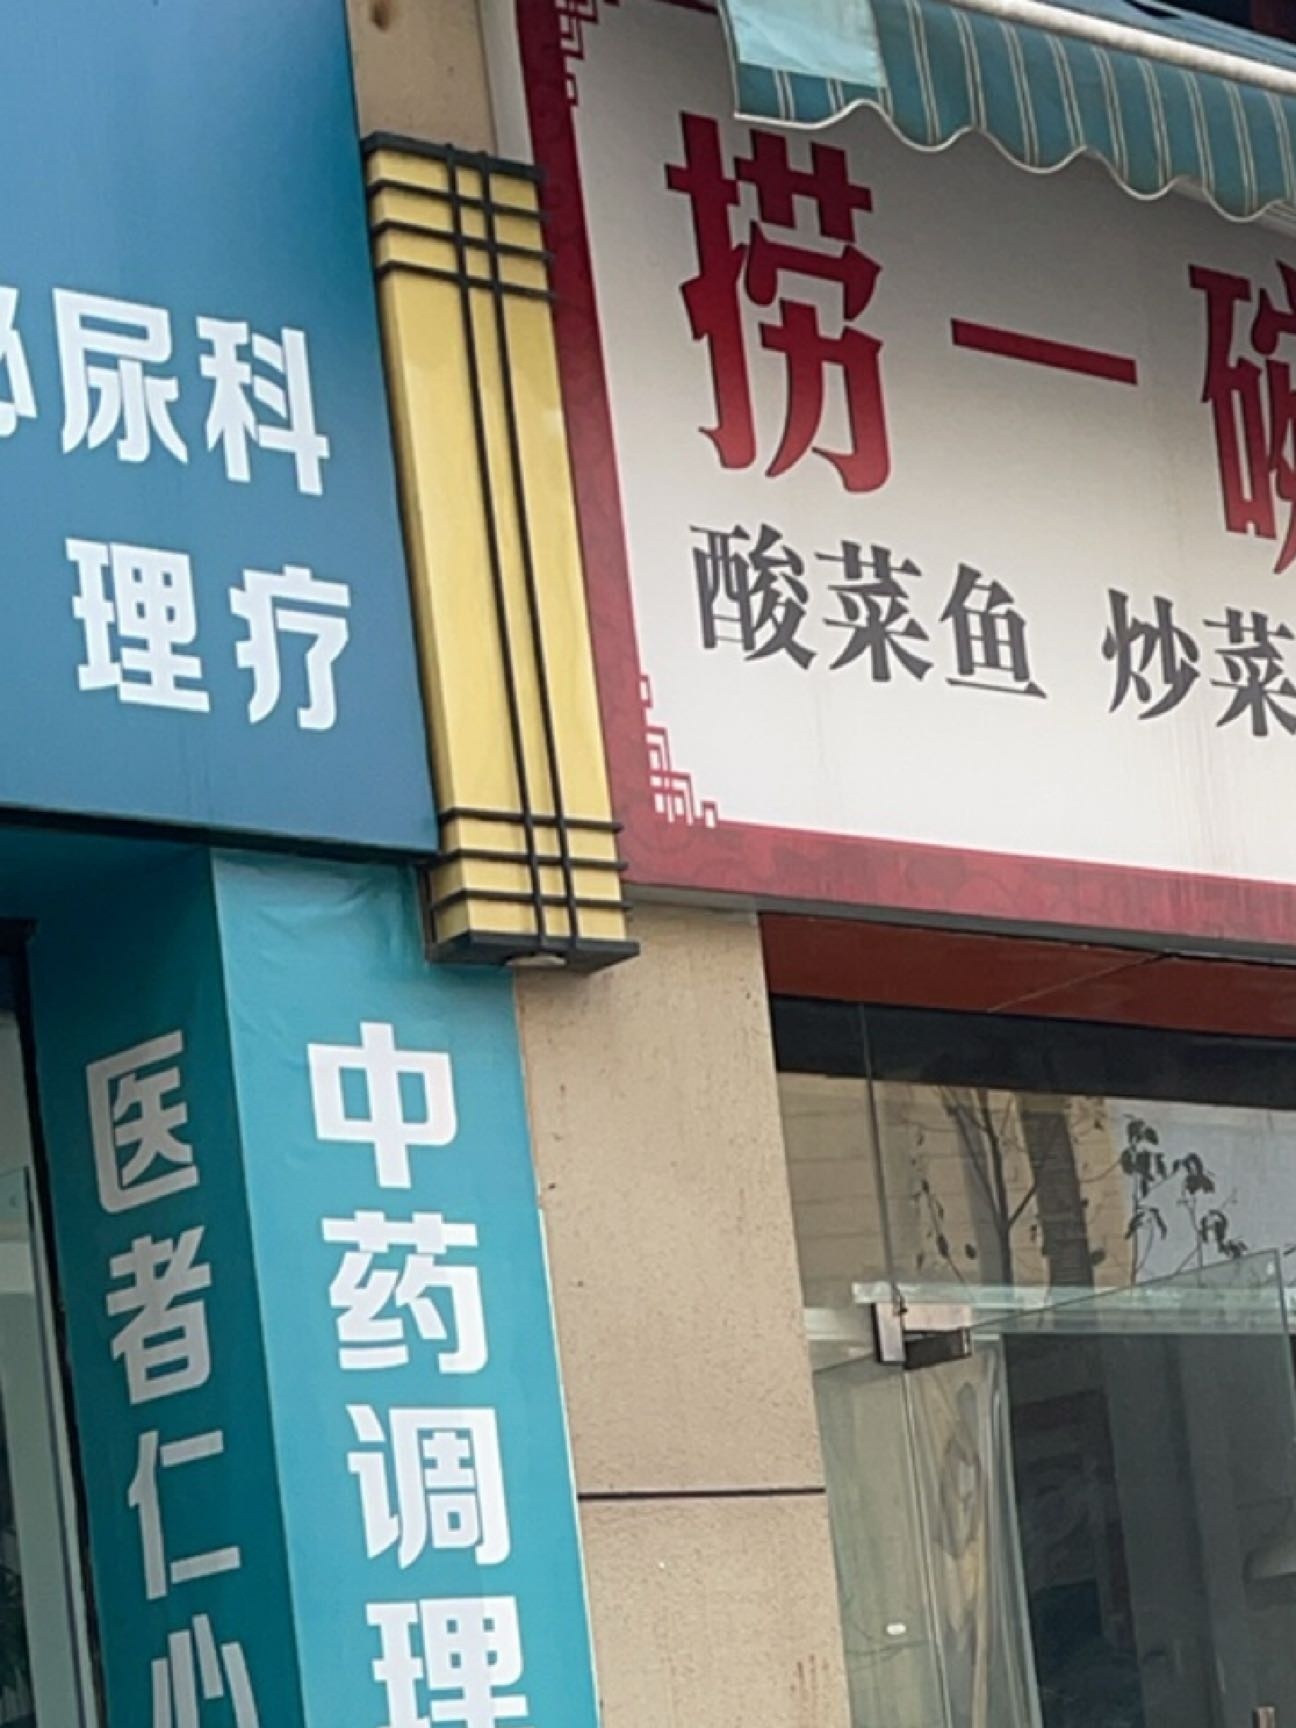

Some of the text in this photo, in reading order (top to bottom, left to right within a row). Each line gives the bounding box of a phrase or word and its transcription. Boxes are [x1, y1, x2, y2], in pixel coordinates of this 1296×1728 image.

[65, 537, 352, 732] 理疗
[689, 523, 1048, 700] 酸菜鱼
